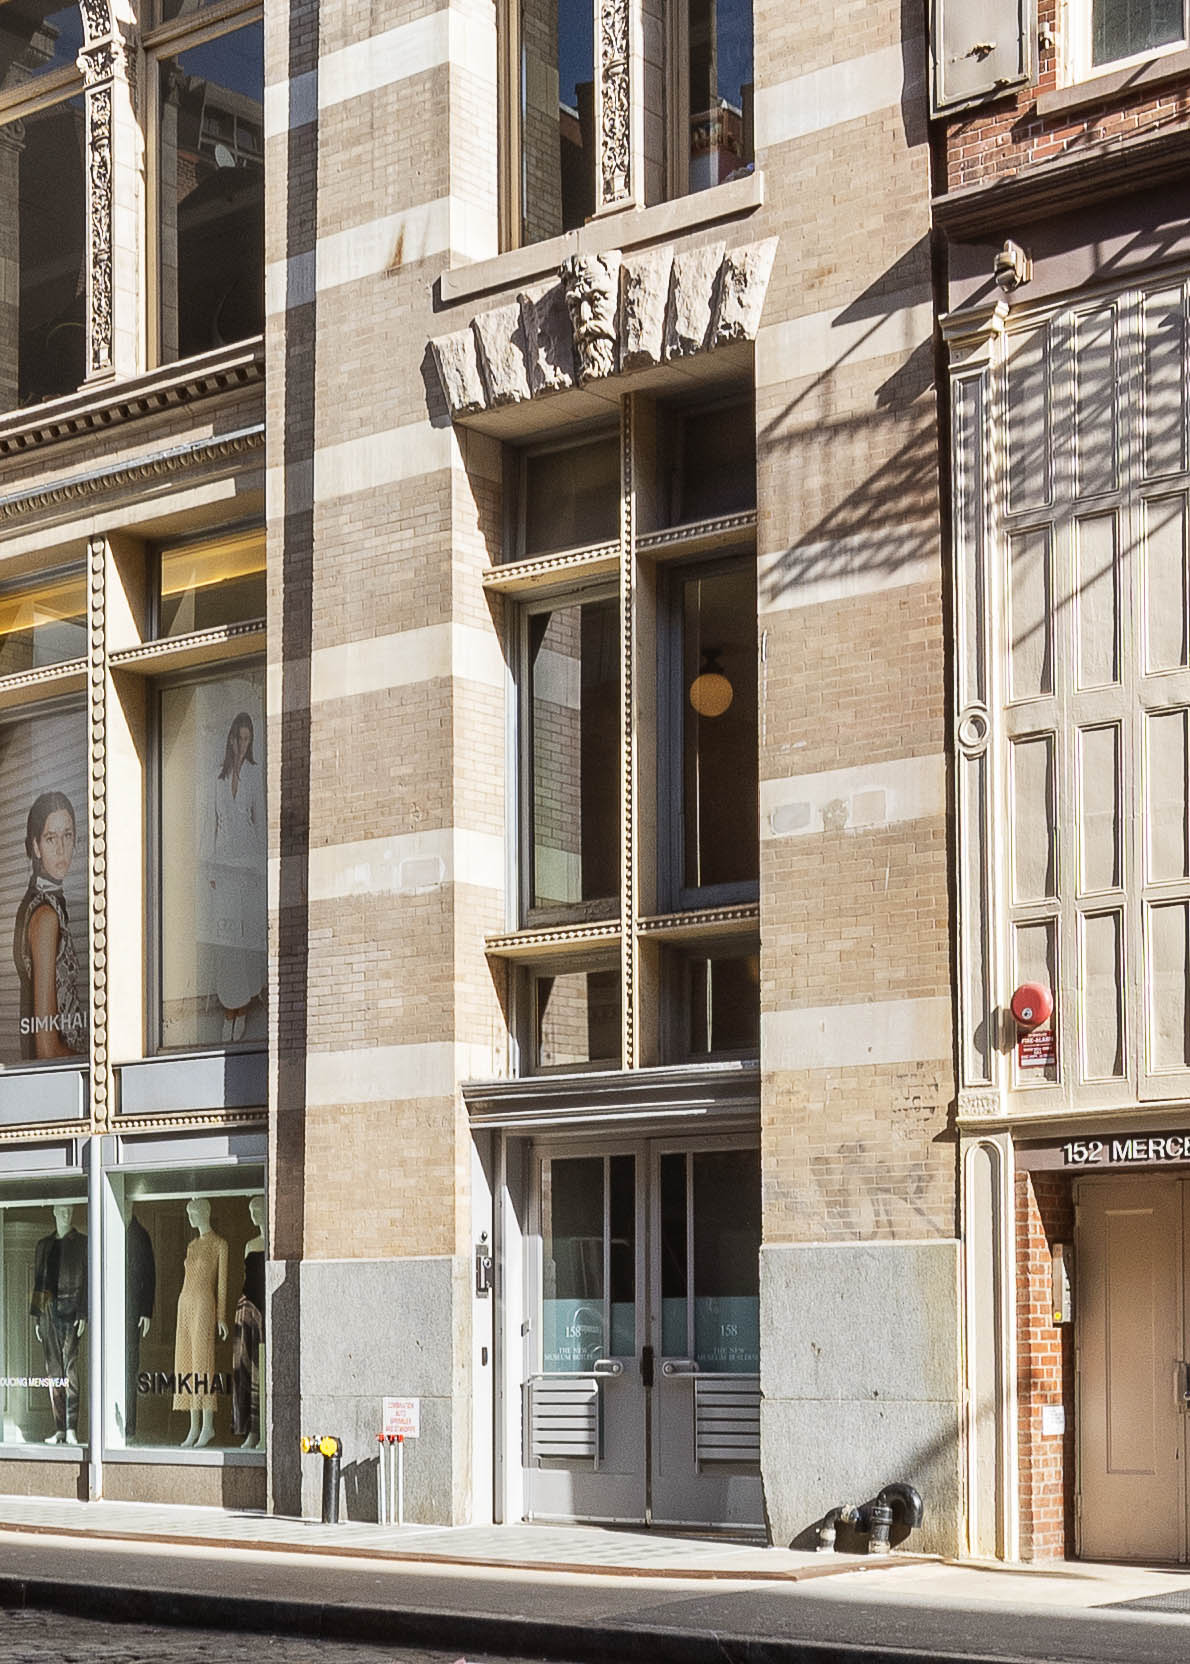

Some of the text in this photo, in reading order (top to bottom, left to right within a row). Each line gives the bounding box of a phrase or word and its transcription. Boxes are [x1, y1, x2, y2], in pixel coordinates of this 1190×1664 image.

[20, 1011, 87, 1034] SIMKHAI
[1063, 1141, 1103, 1163] 152
[565, 1325, 581, 1338] 158
[721, 1324, 738, 1337] 158
[28, 1376, 70, 1388] MENSWEAR
[138, 1371, 232, 1395] SIMKHAI
